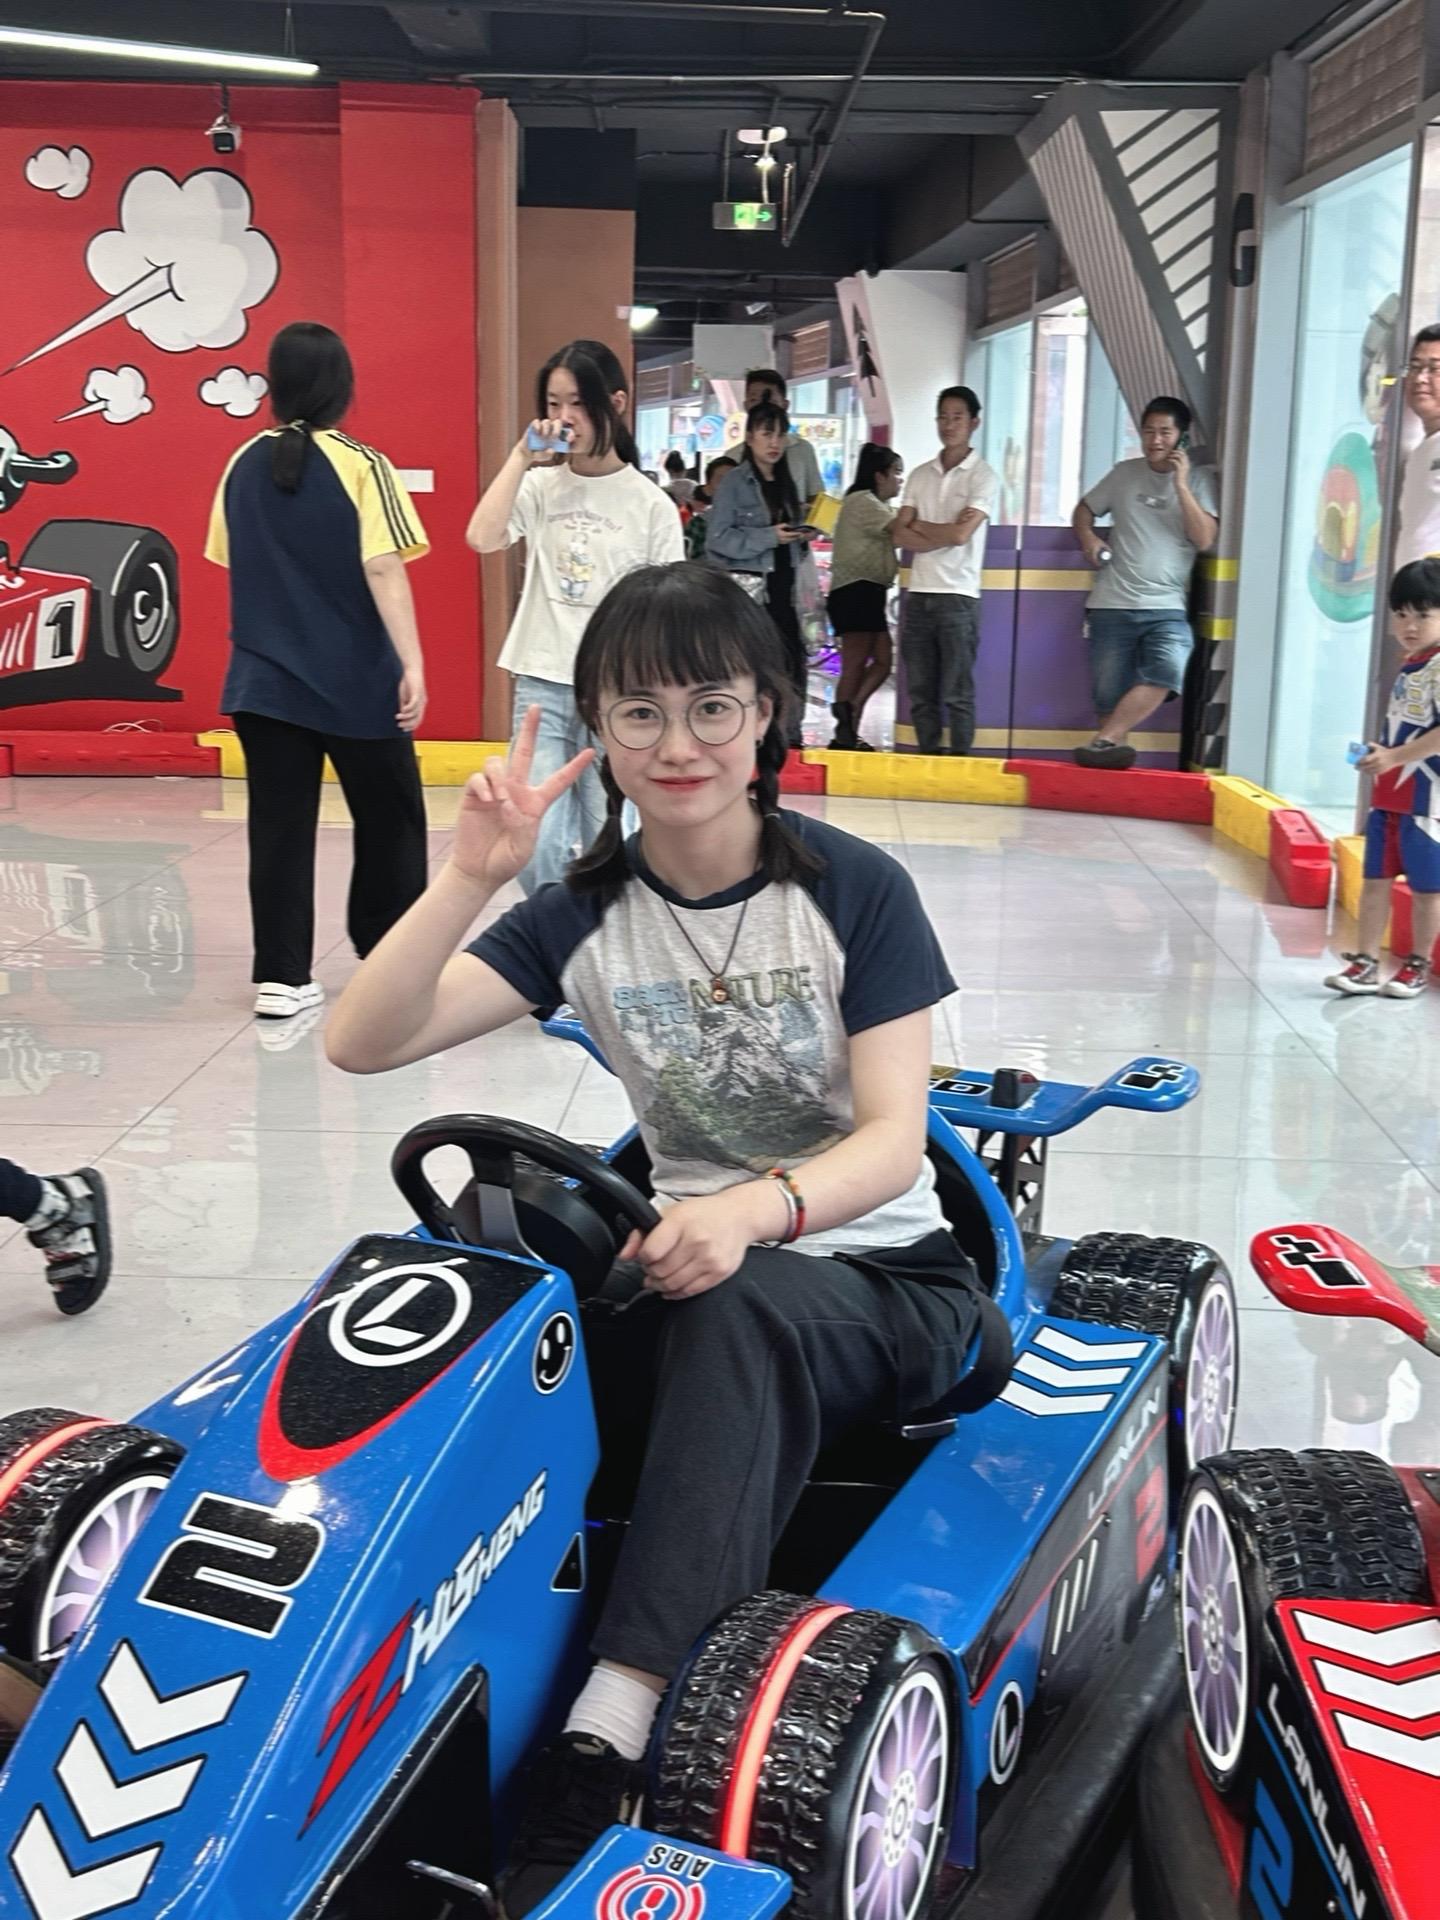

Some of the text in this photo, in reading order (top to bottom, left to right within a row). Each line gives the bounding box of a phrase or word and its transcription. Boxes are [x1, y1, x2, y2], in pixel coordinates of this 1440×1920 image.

[45, 601, 76, 658] 1
[688, 966, 816, 1011] NTURE
[135, 1491, 328, 1640] 2
[1135, 1464, 1166, 1585] 2
[644, 1842, 714, 1881] ABS
[1249, 1777, 1294, 1920] 2
[1267, 1683, 1367, 1920] LANLIN
